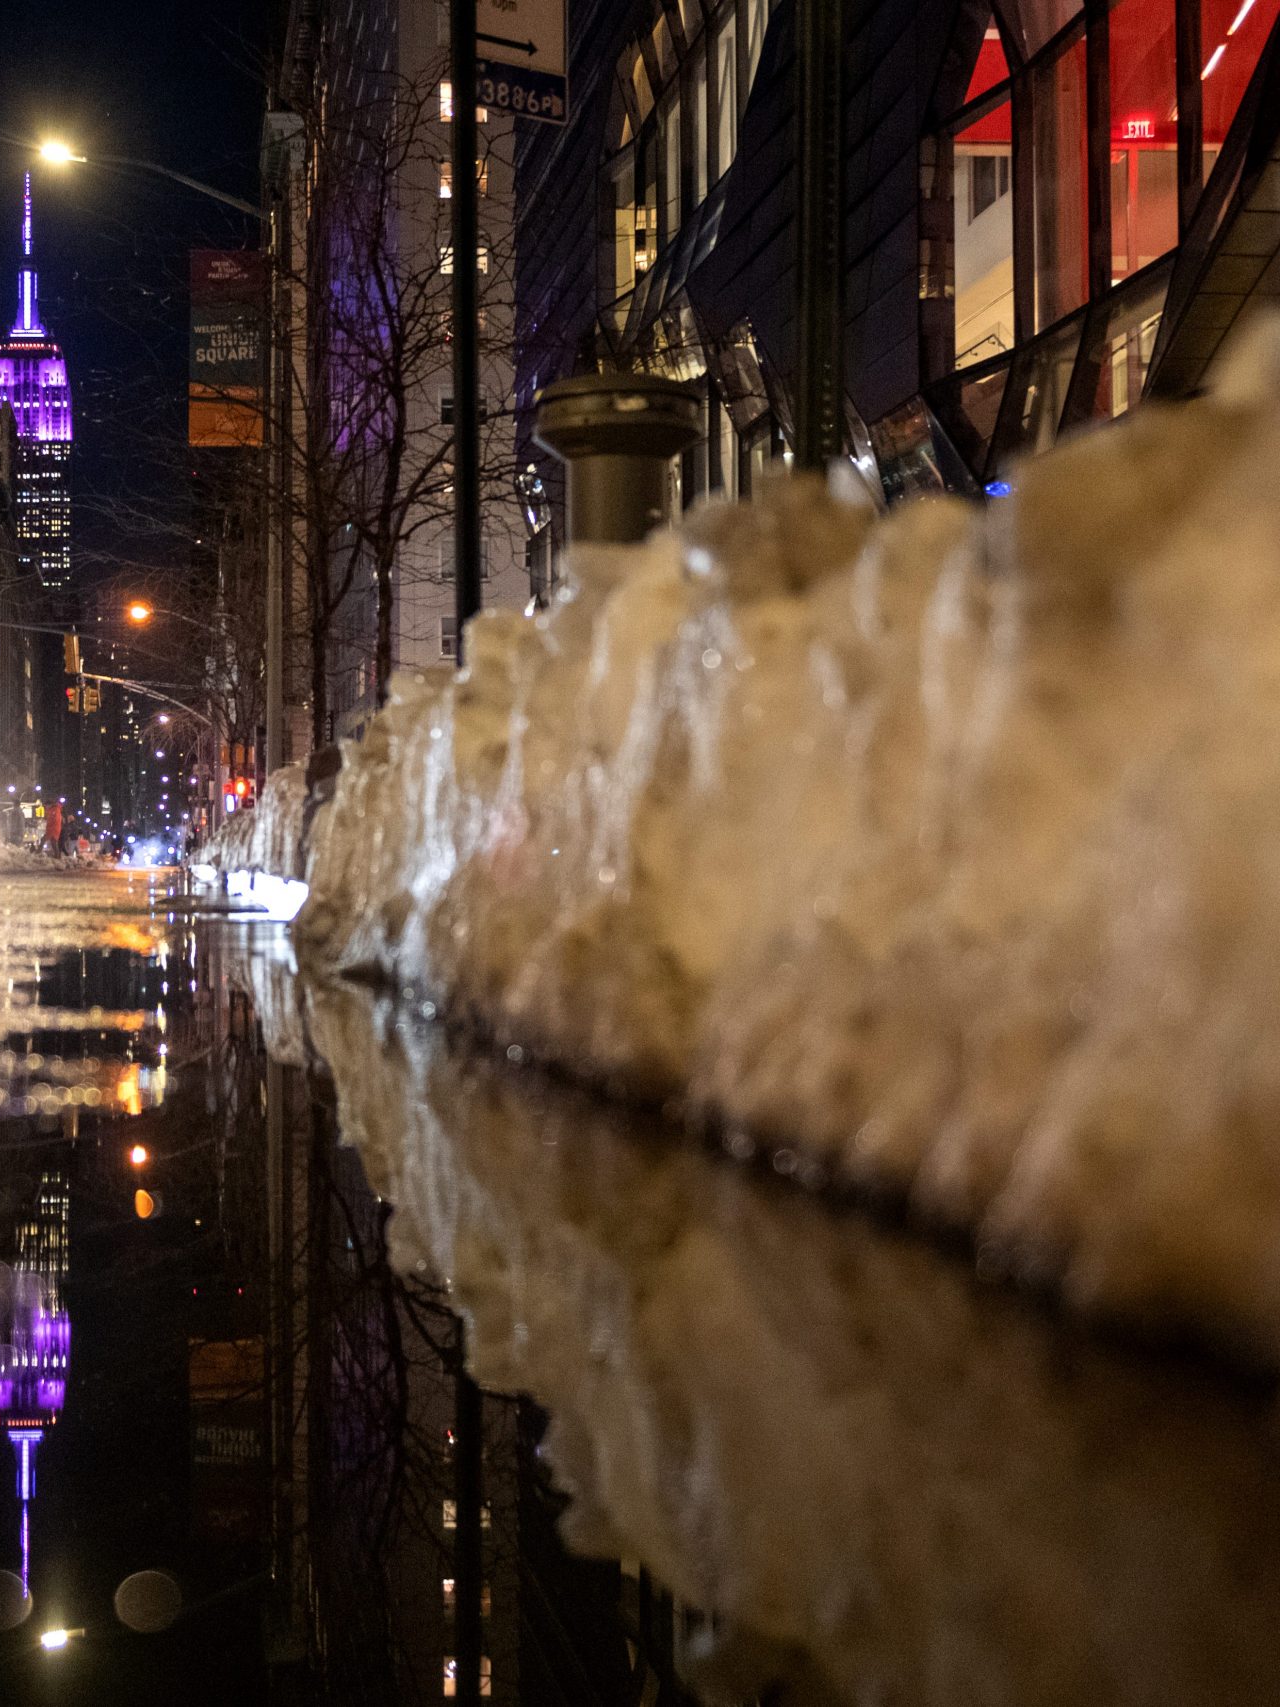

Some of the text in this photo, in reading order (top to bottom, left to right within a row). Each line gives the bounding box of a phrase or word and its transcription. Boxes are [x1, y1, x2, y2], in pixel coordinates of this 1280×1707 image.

[1128, 120, 1150, 138] EXIT
[193, 325, 229, 334] WELCOM
[195, 346, 258, 365] SQUARE
